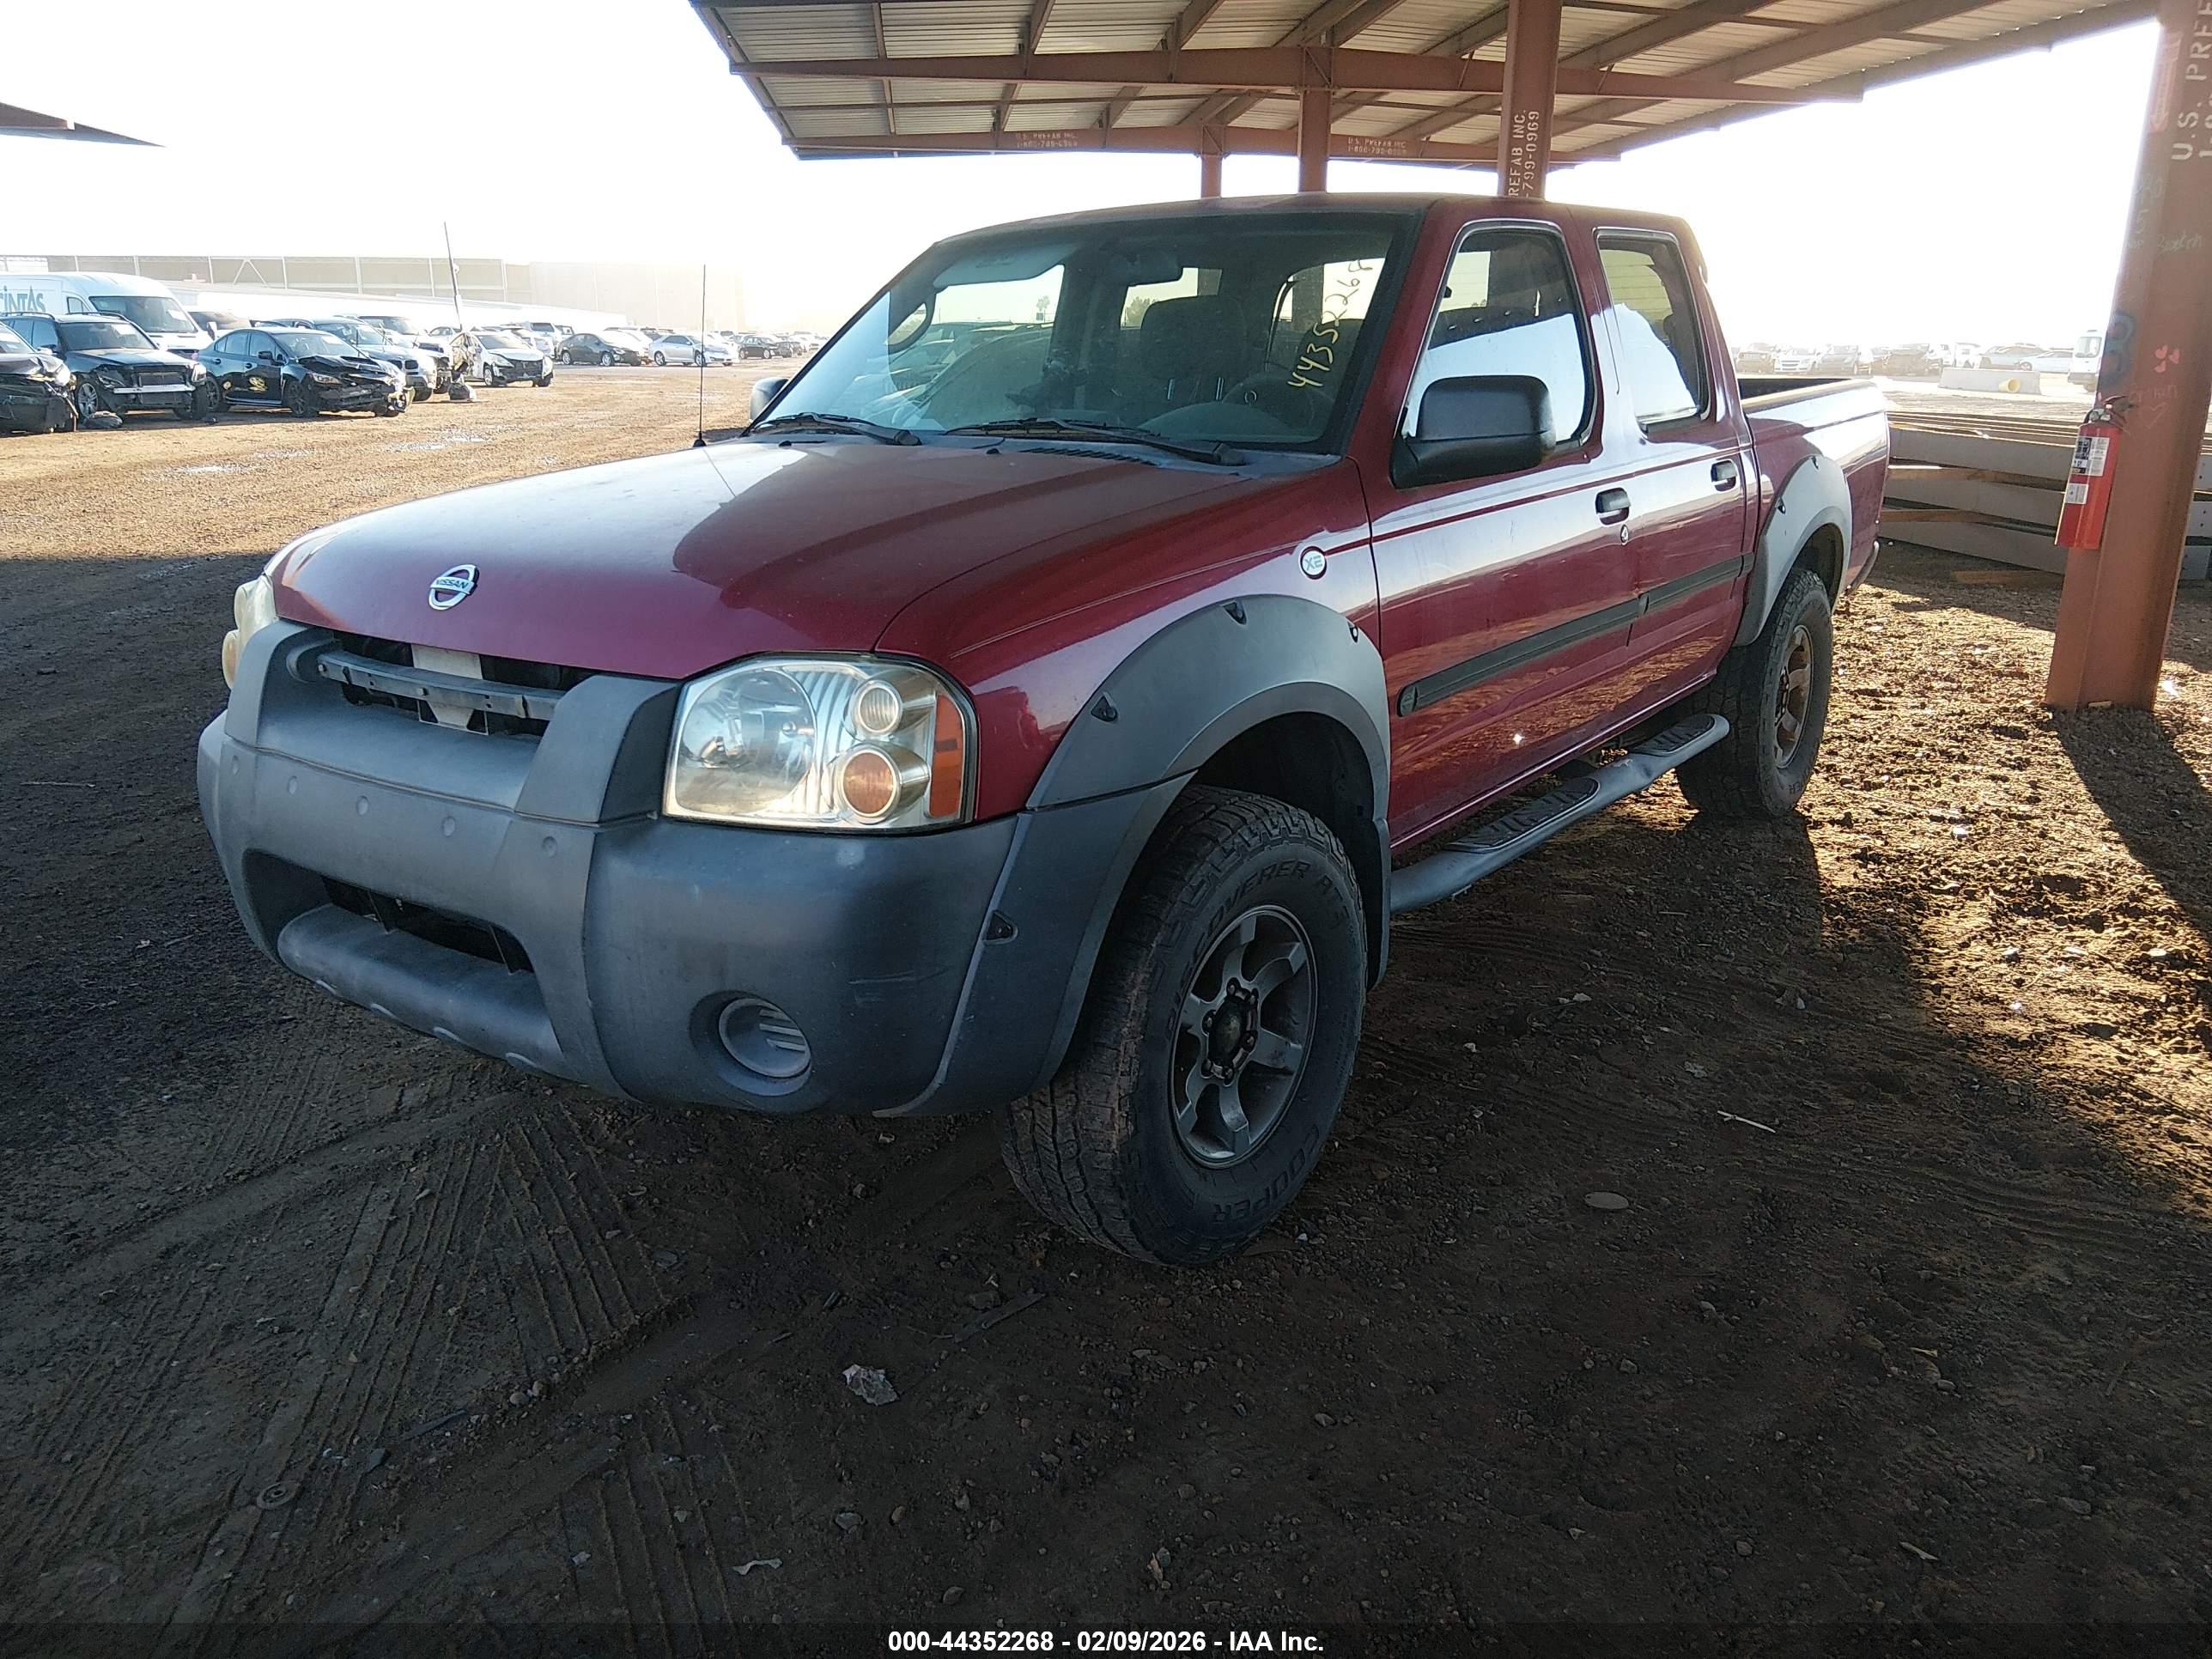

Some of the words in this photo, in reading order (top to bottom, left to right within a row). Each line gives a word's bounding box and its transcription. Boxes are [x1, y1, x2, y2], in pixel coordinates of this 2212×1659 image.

[1512, 109, 1527, 138] INC.
[2171, 101, 2203, 161] U.S.
[1304, 555, 1323, 571] XE
[435, 578, 470, 590] NISSAN
[1212, 1123, 1320, 1224] COOPER
